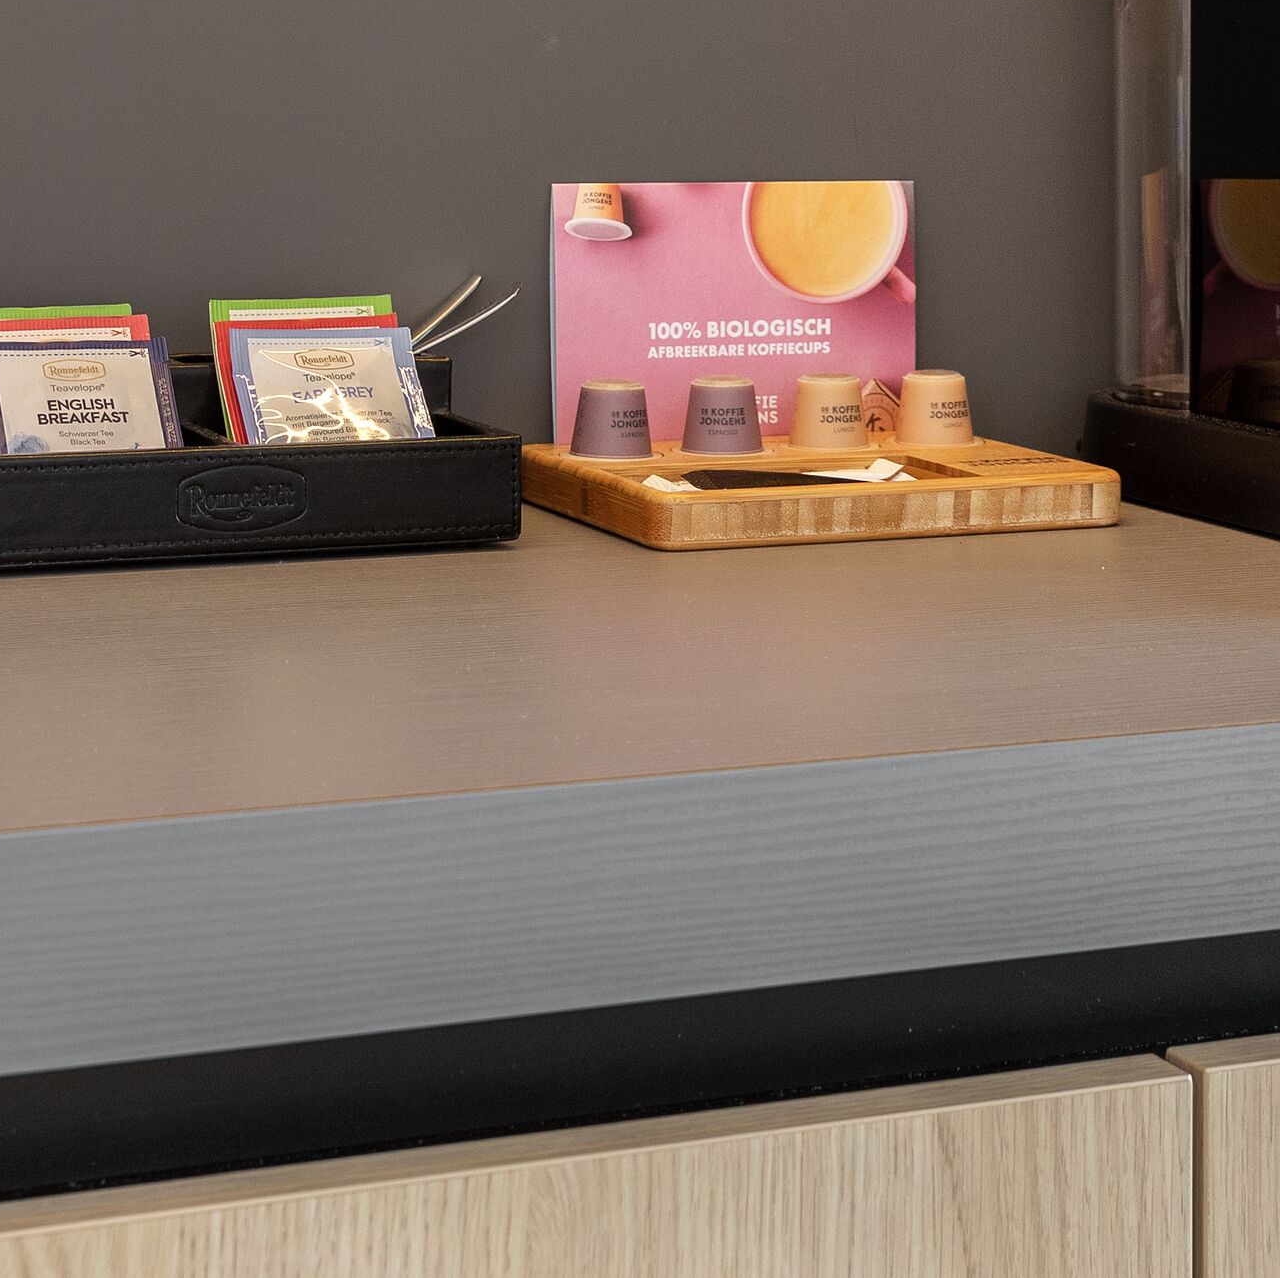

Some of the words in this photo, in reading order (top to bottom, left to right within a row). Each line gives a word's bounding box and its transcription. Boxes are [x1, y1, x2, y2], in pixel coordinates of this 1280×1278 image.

[648, 321, 702, 339] 100%
[706, 318, 832, 338] BIOLOGISCH
[647, 343, 745, 359] AFBREEKBARE
[748, 341, 831, 356] KOFFIECUPS
[299, 354, 348, 367] Ronnefeldt
[48, 365, 100, 378] Ronnefeldt
[47, 398, 115, 411] ENGLISH
[832, 404, 860, 414] KOFFIE
[37, 411, 129, 425] BREAKFAST
[711, 407, 746, 416] KOFFIE
[820, 413, 862, 423] JONGENS
[699, 417, 747, 425] JONGENS
